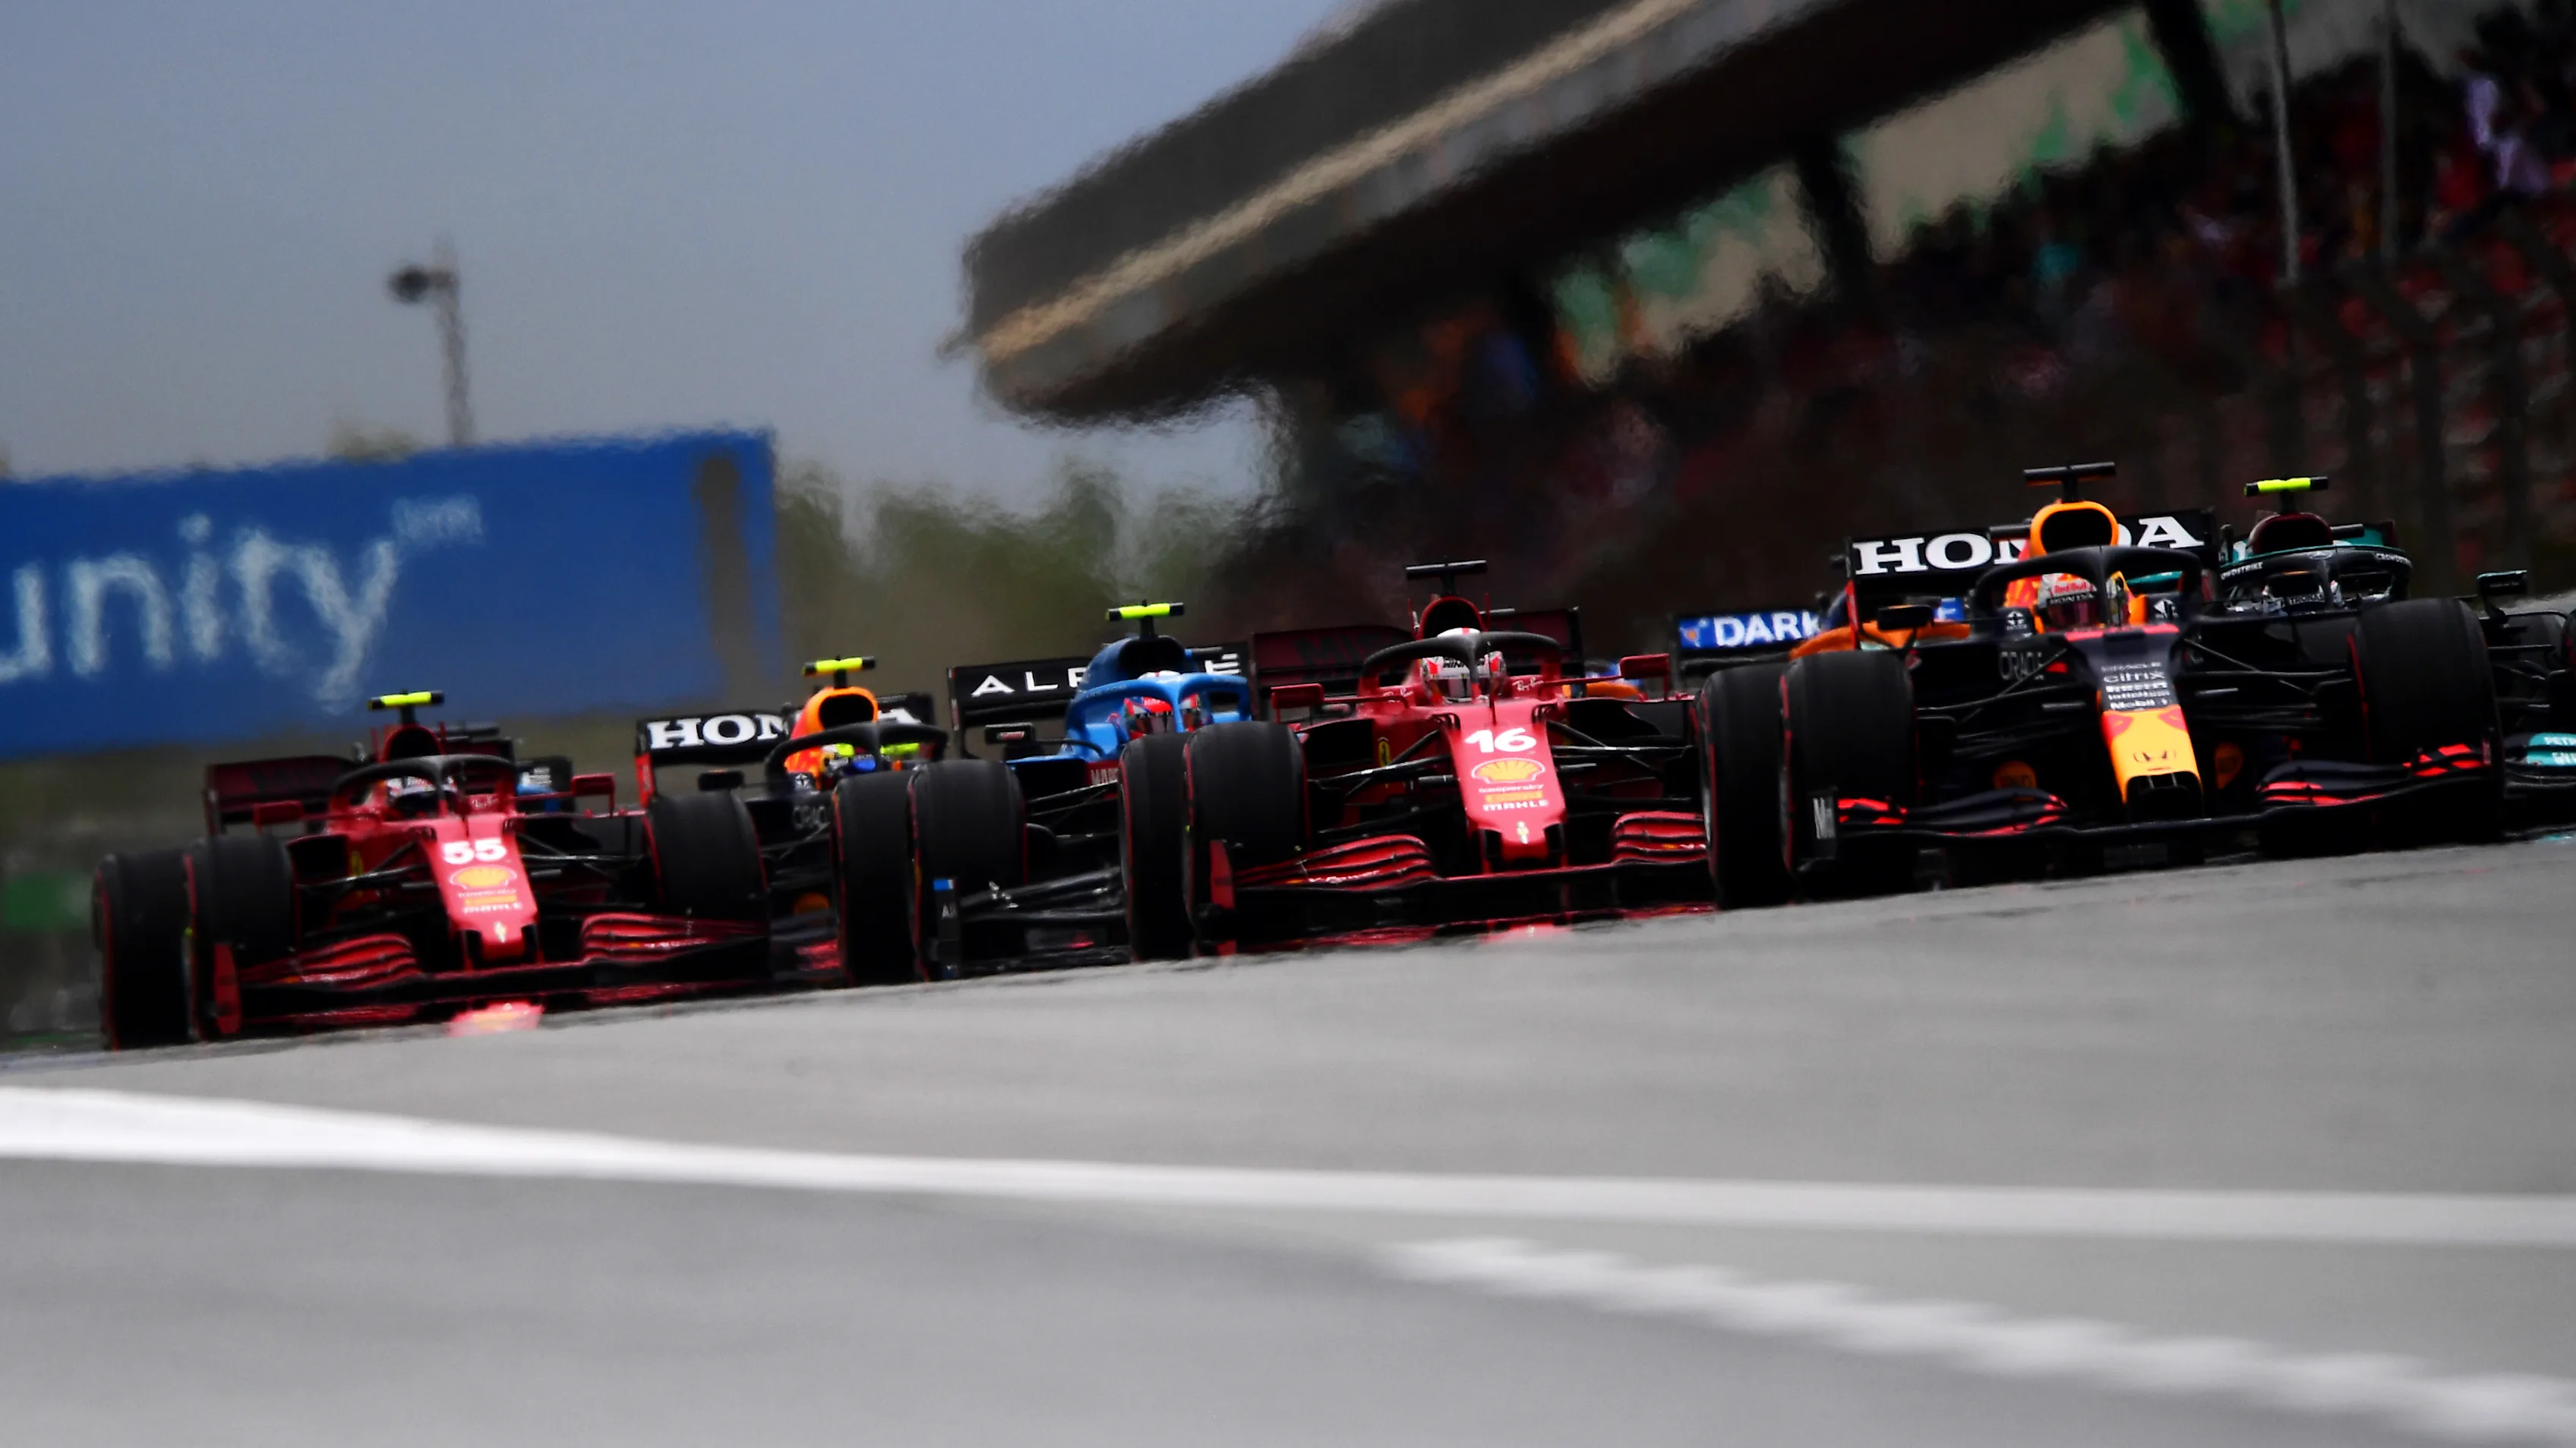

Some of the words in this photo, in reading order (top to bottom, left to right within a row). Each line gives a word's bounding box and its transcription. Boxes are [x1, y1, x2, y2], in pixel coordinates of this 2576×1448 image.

[1852, 515, 2205, 576] HONA
[970, 651, 1242, 699] ALPE
[1464, 727, 1537, 753] 16
[442, 837, 507, 865] 55
